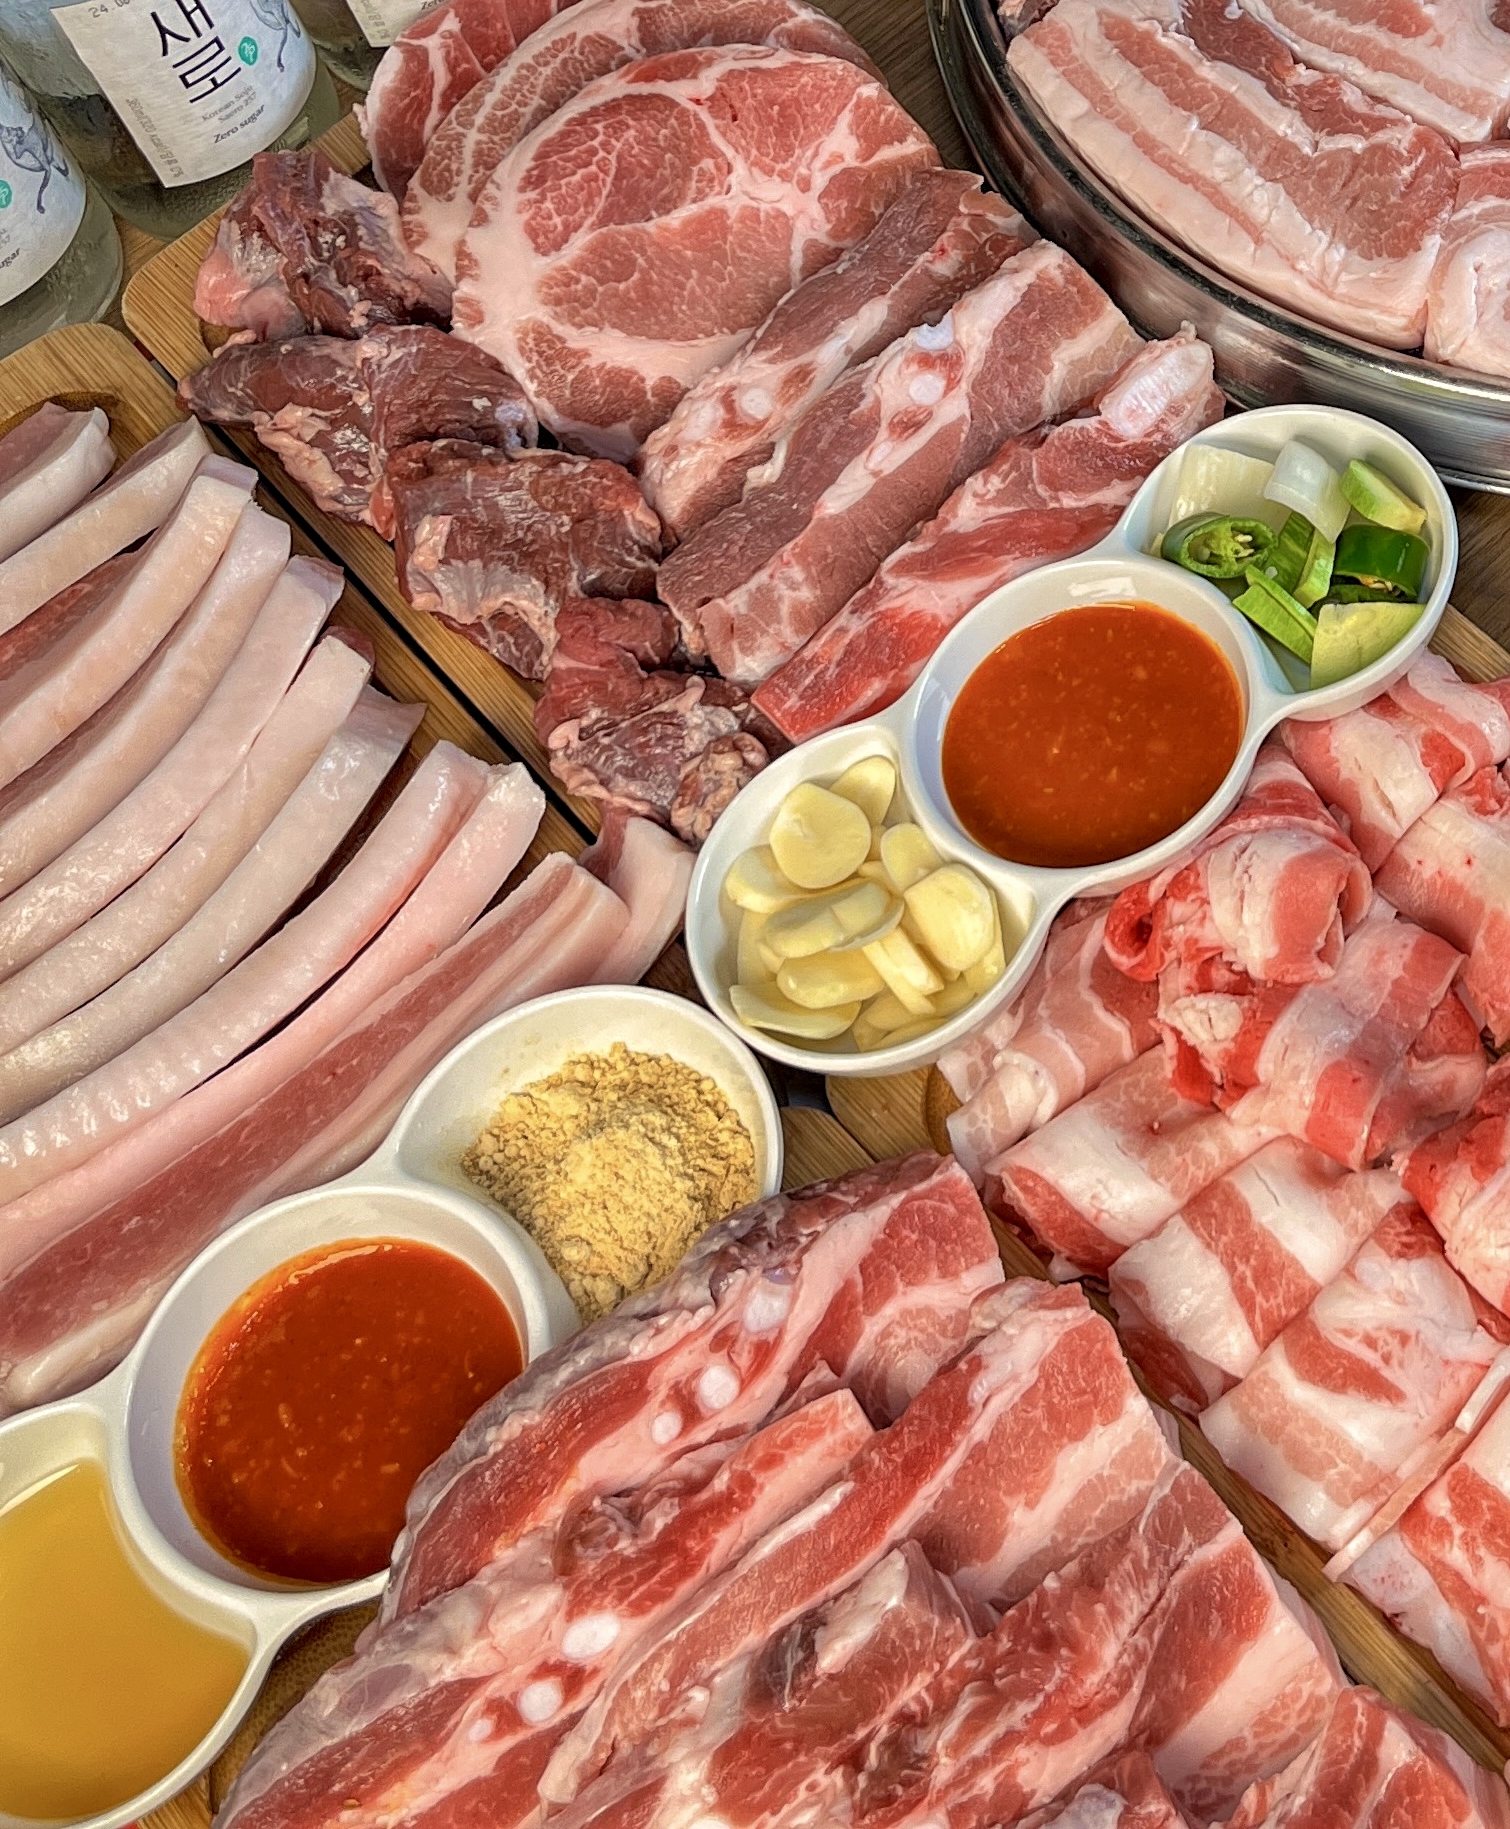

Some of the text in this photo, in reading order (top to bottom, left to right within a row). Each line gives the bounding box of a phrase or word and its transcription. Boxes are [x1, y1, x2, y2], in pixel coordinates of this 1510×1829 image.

[202, 100, 235, 122] Korean
[218, 104, 244, 123] Saero
[214, 104, 265, 144] Zero sugar
[0, 247, 21, 269] ugar
